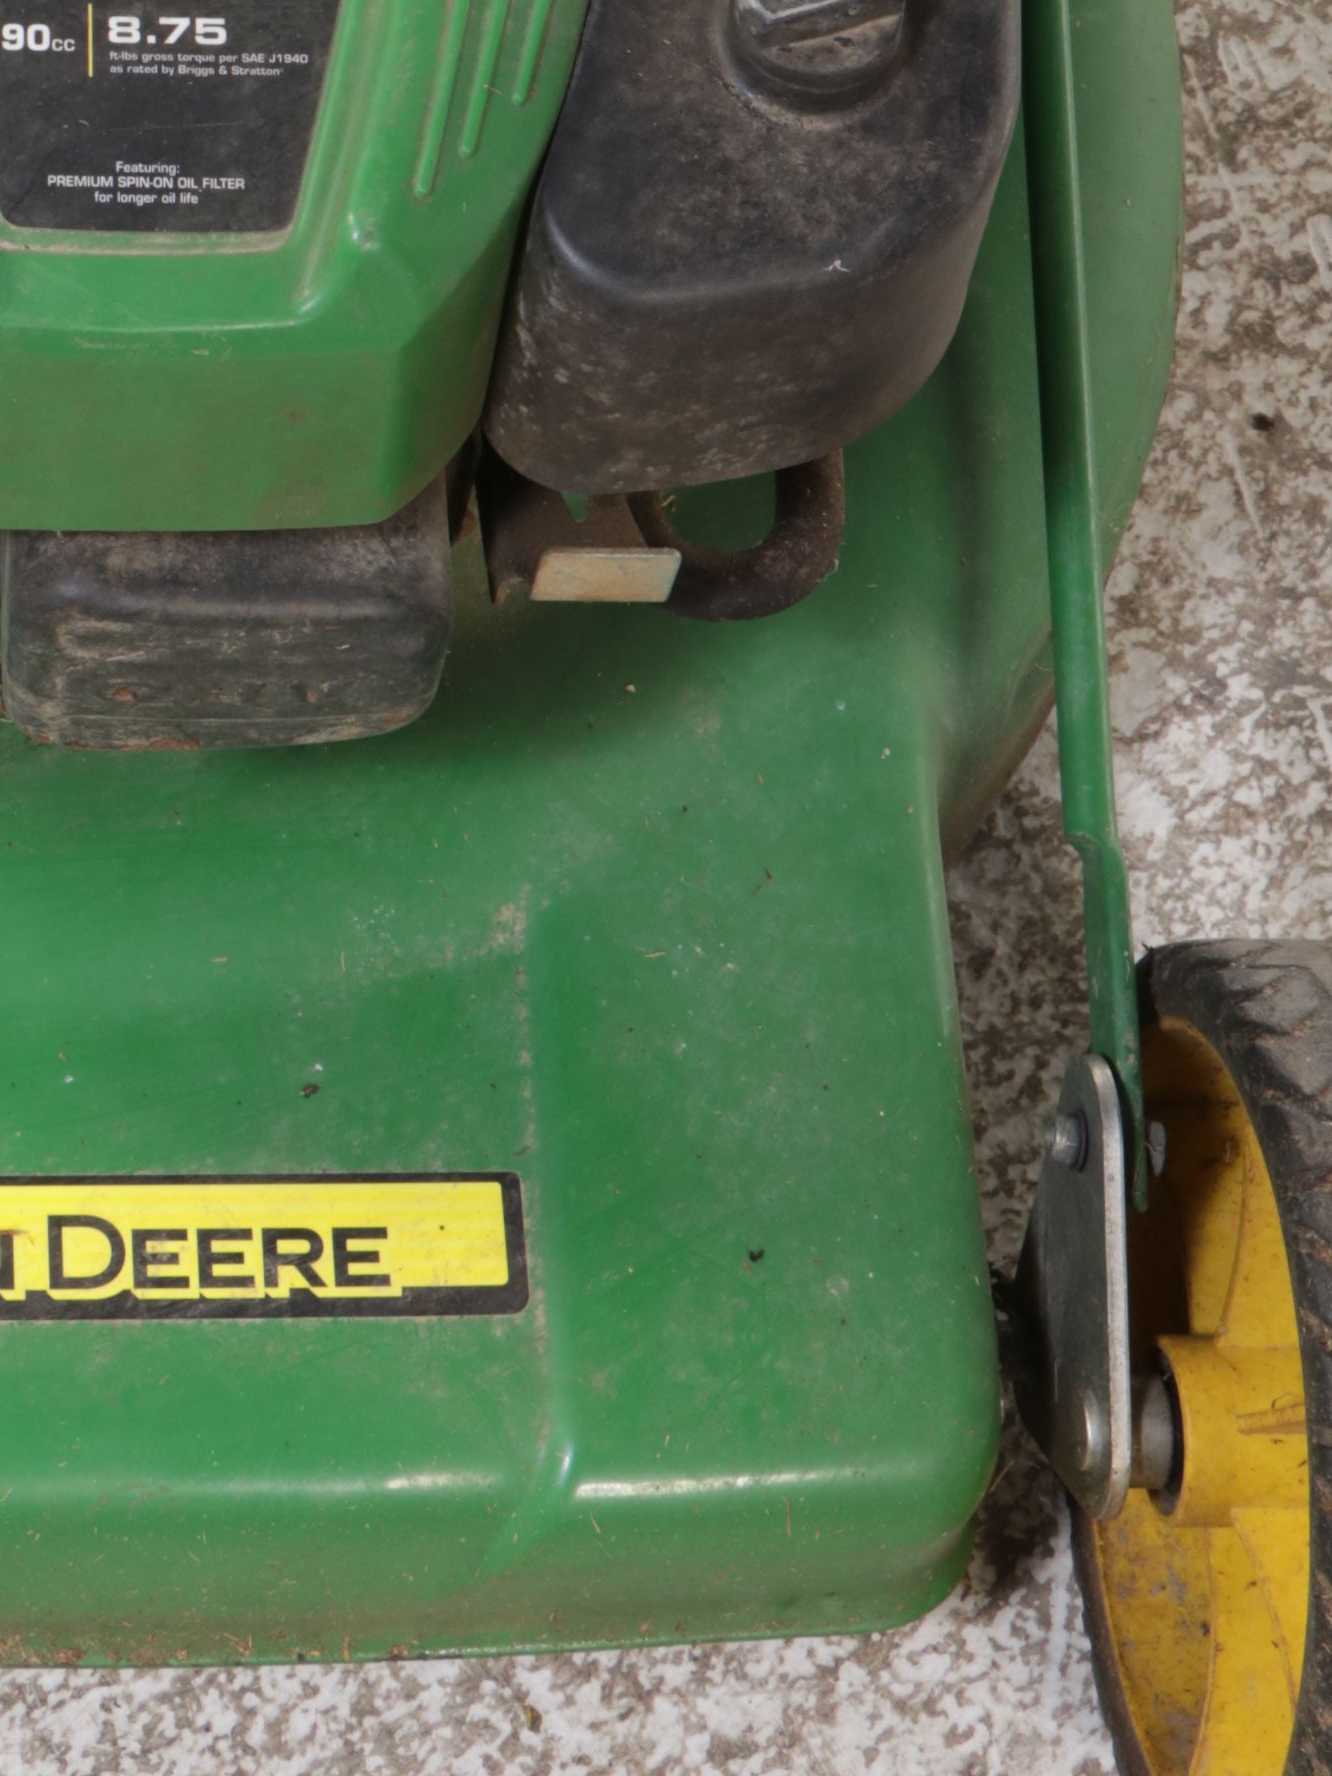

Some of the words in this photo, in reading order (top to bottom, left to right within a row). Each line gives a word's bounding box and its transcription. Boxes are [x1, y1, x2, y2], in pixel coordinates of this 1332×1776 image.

[108, 15, 228, 46] 8.75
[110, 51, 138, 61] ft-lbs
[142, 53, 174, 63] gross
[177, 53, 215, 64] torque
[219, 54, 238, 64] per
[242, 53, 265, 62] SAE
[269, 54, 308, 63] J1940
[127, 65, 157, 74] rated
[162, 65, 174, 76] by
[178, 66, 215, 77] Briggs
[219, 66, 228, 74] &
[116, 161, 180, 176] Featuring:
[47, 175, 113, 187] PREMIUM
[118, 176, 173, 189] SPIN-ON
[178, 177, 198, 189] OIL
[202, 178, 245, 189] FILTER
[94, 192, 113, 202] for
[117, 192, 157, 206] longer
[161, 192, 175, 203] oil
[180, 193, 199, 204] life
[47, 1214, 390, 1290] DEERE
